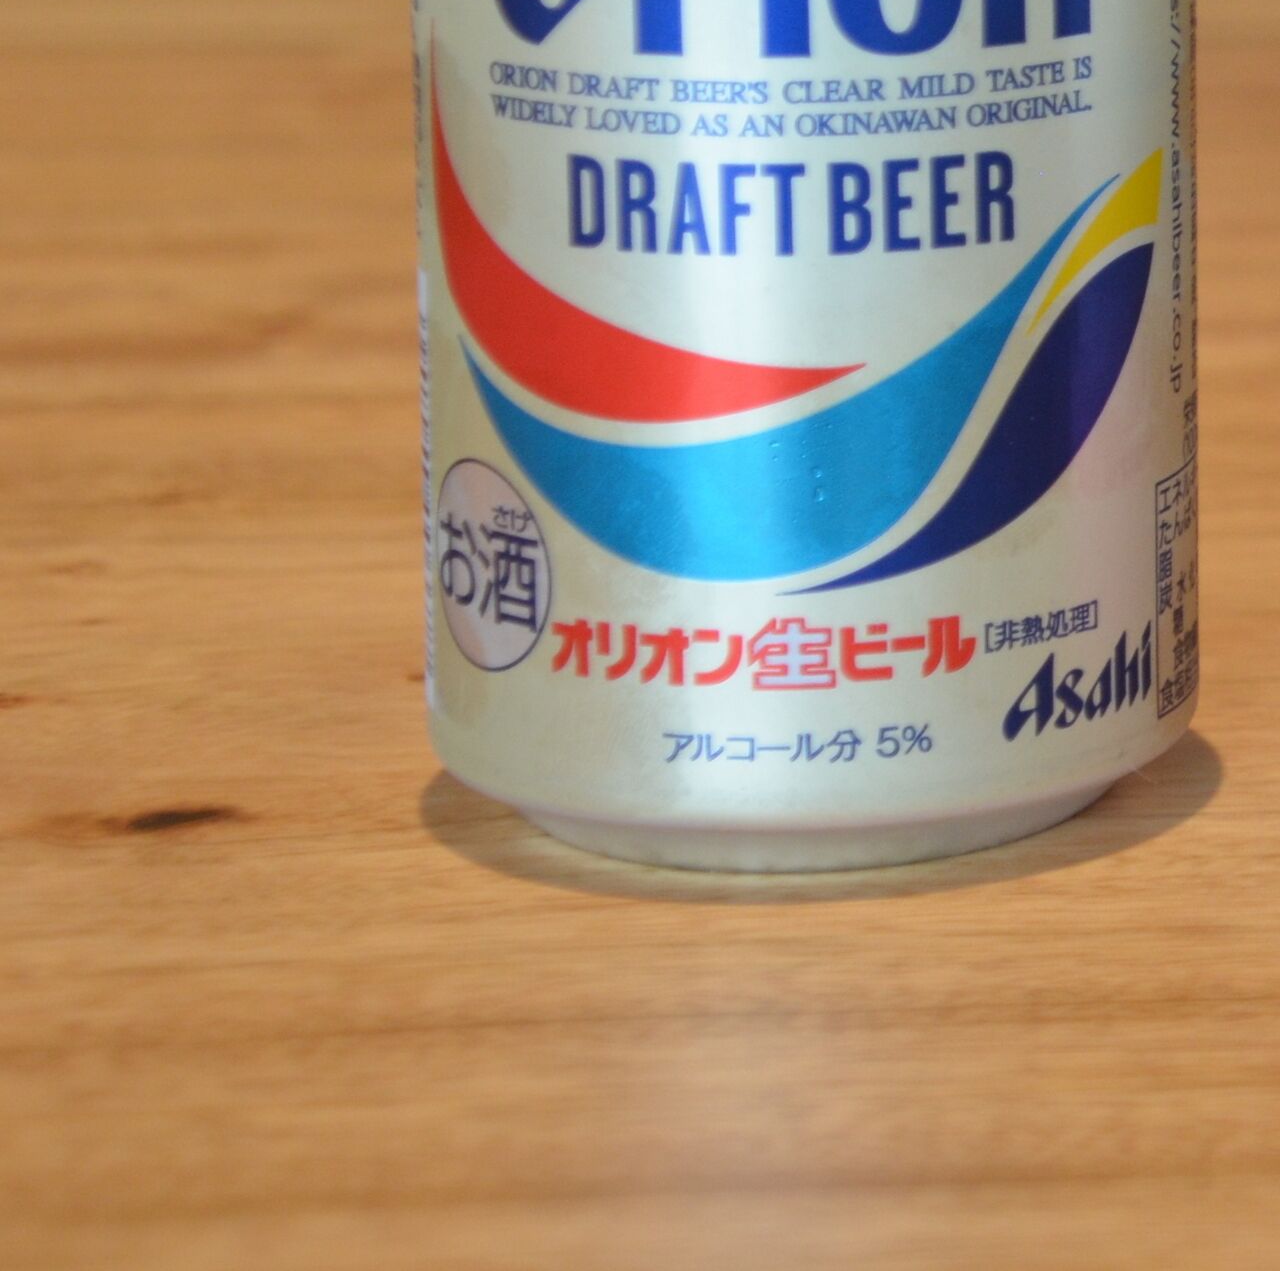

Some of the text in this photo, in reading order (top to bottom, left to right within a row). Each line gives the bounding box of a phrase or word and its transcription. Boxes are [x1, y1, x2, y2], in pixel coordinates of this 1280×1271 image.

[490, 56, 1093, 104] ORION DRAFT BEER'S CLEAR MILD TASTE IS
[490, 90, 1093, 138] WIDELY LOVED AS AN OKINAWAN ORIGINAL.
[568, 150, 1016, 257] DRAFT BEER
[491, 505, 535, 528] さけ
[437, 516, 541, 634] お酒
[550, 616, 978, 691] オリオン生ビール
[1002, 619, 1153, 742] Asahi
[663, 723, 933, 764] アルコール分 5%
